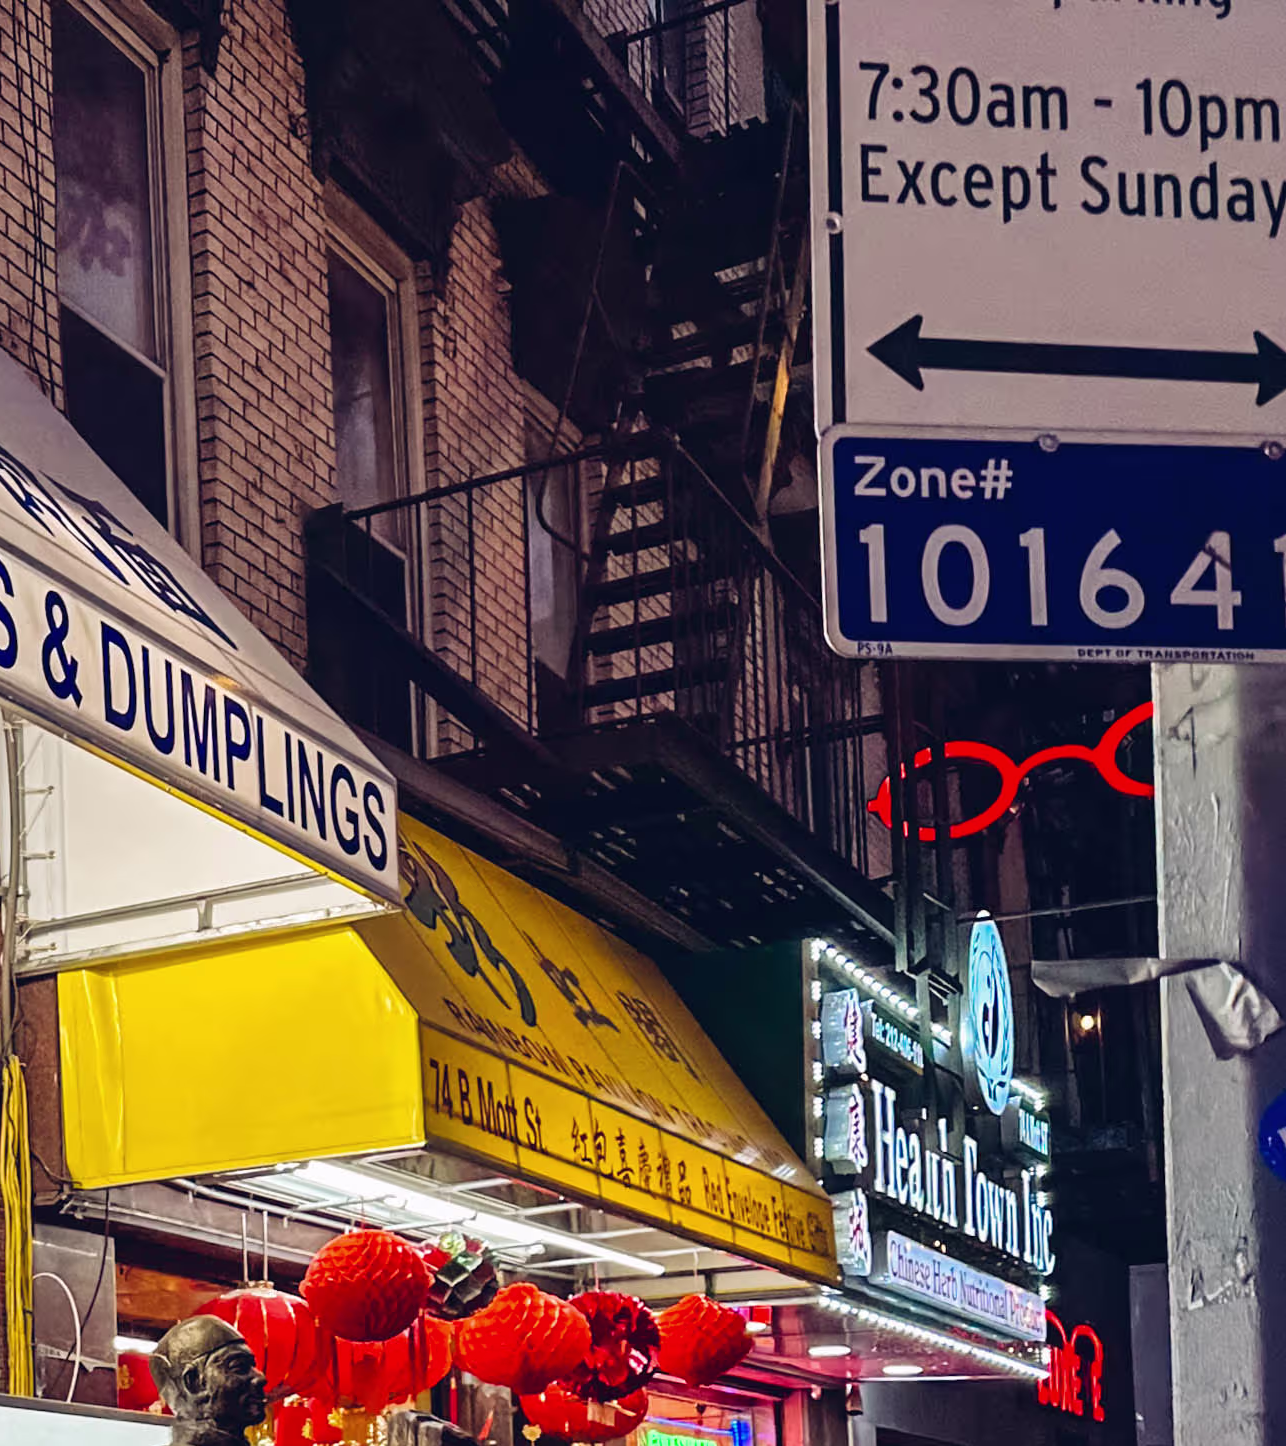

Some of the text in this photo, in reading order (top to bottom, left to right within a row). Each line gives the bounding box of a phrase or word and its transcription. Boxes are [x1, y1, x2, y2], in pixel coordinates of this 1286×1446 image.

[859, 62, 1068, 131] 7:30am
[1136, 78, 1279, 152] 10pm
[859, 144, 1286, 238] Except Sunday
[854, 455, 1013, 501] Zone#
[1078, 648, 1256, 661] DEPT OF TRANSPORTATION
[41, 590, 82, 709] &
[101, 621, 387, 871] DUMPLINGS
[442, 997, 570, 1078] RAINBOW
[430, 1059, 454, 1119] 74
[458, 1068, 473, 1125] B
[477, 1077, 523, 1146] Mott
[702, 1166, 725, 1215] Red
[725, 1177, 772, 1233] Envelope
[964, 1135, 1020, 1258] Town
[890, 1240, 930, 1290] Chinese
[933, 1259, 958, 1300] Herb
[960, 1270, 1008, 1320] Nutritional
